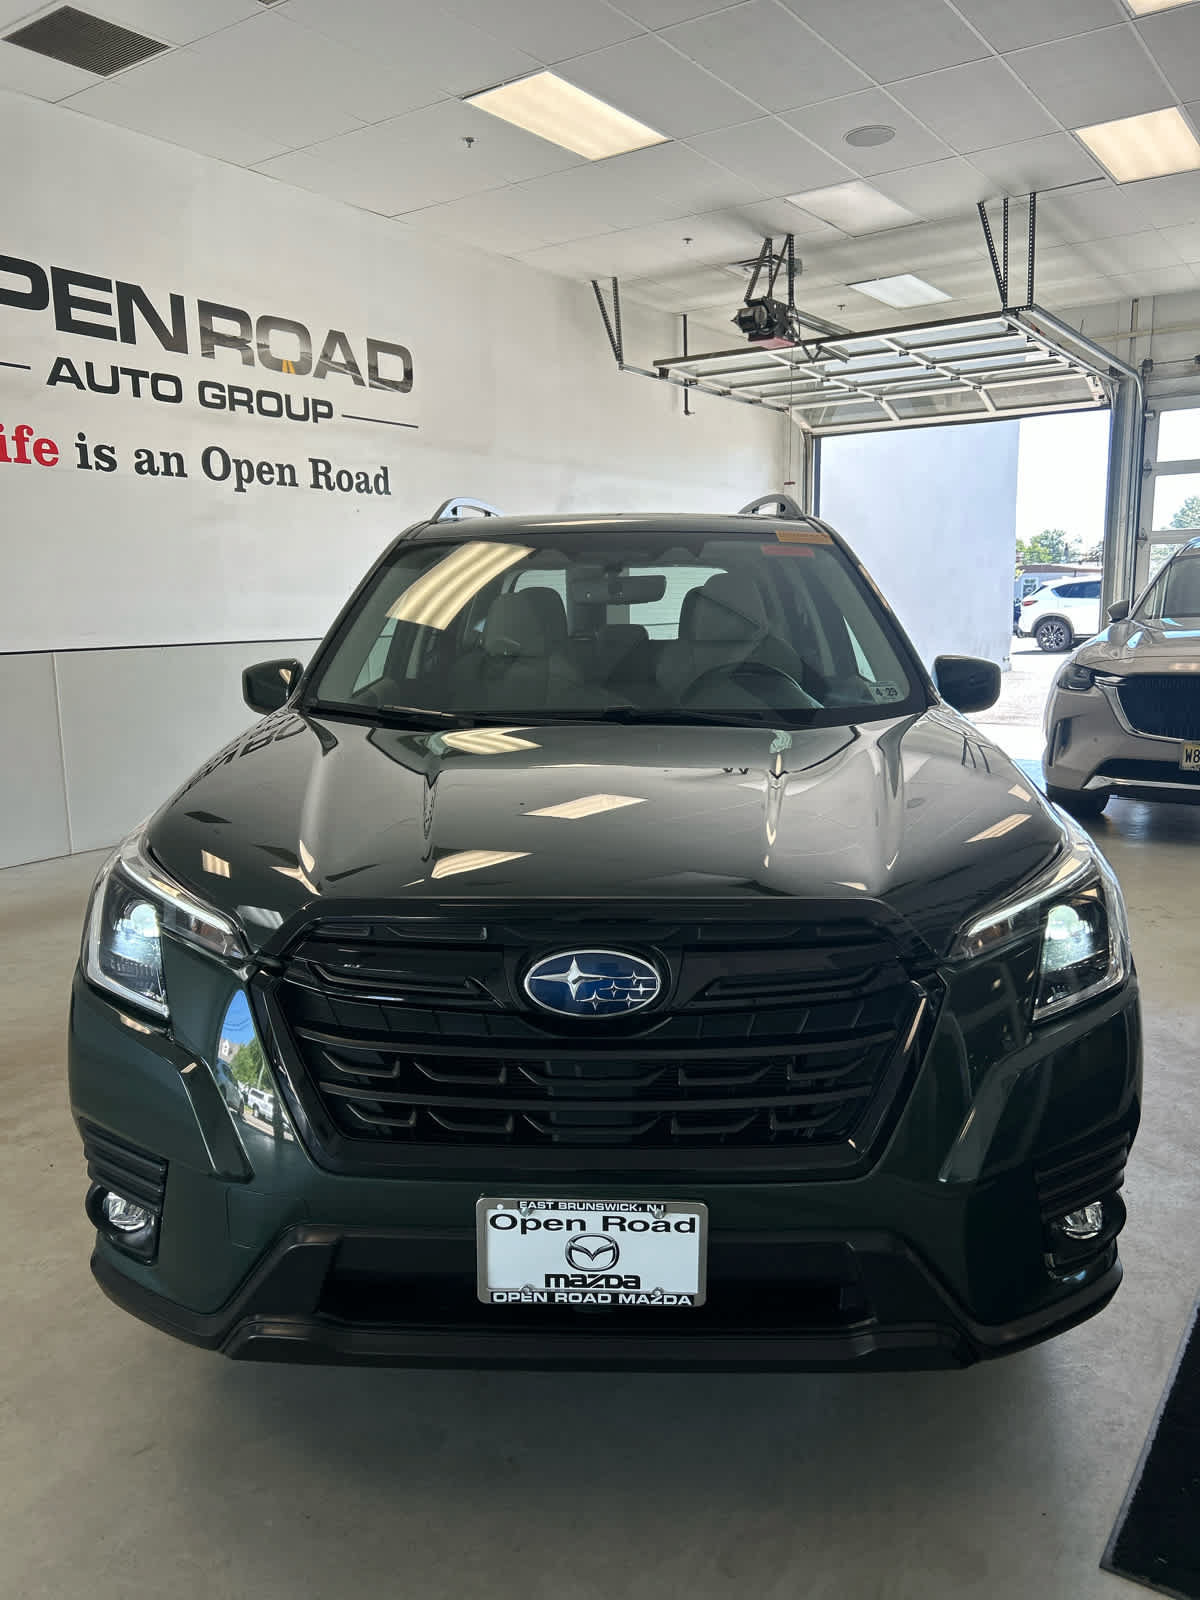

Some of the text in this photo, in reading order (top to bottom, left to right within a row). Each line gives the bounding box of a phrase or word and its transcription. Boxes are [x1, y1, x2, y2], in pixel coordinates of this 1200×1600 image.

[197, 299, 414, 394] ROAD
[46, 357, 334, 424] AUTO GROUP
[75, 432, 118, 473] is
[134, 448, 189, 479] an
[202, 445, 299, 493] Open
[308, 457, 391, 496] Road
[519, 1201, 554, 1210] EAST
[558, 1202, 642, 1212] BRUNSWICK,
[489, 1214, 696, 1235] Open Road
[544, 1274, 641, 1290] mazda
[493, 1291, 693, 1306] OPEN ROAD MAZDA
